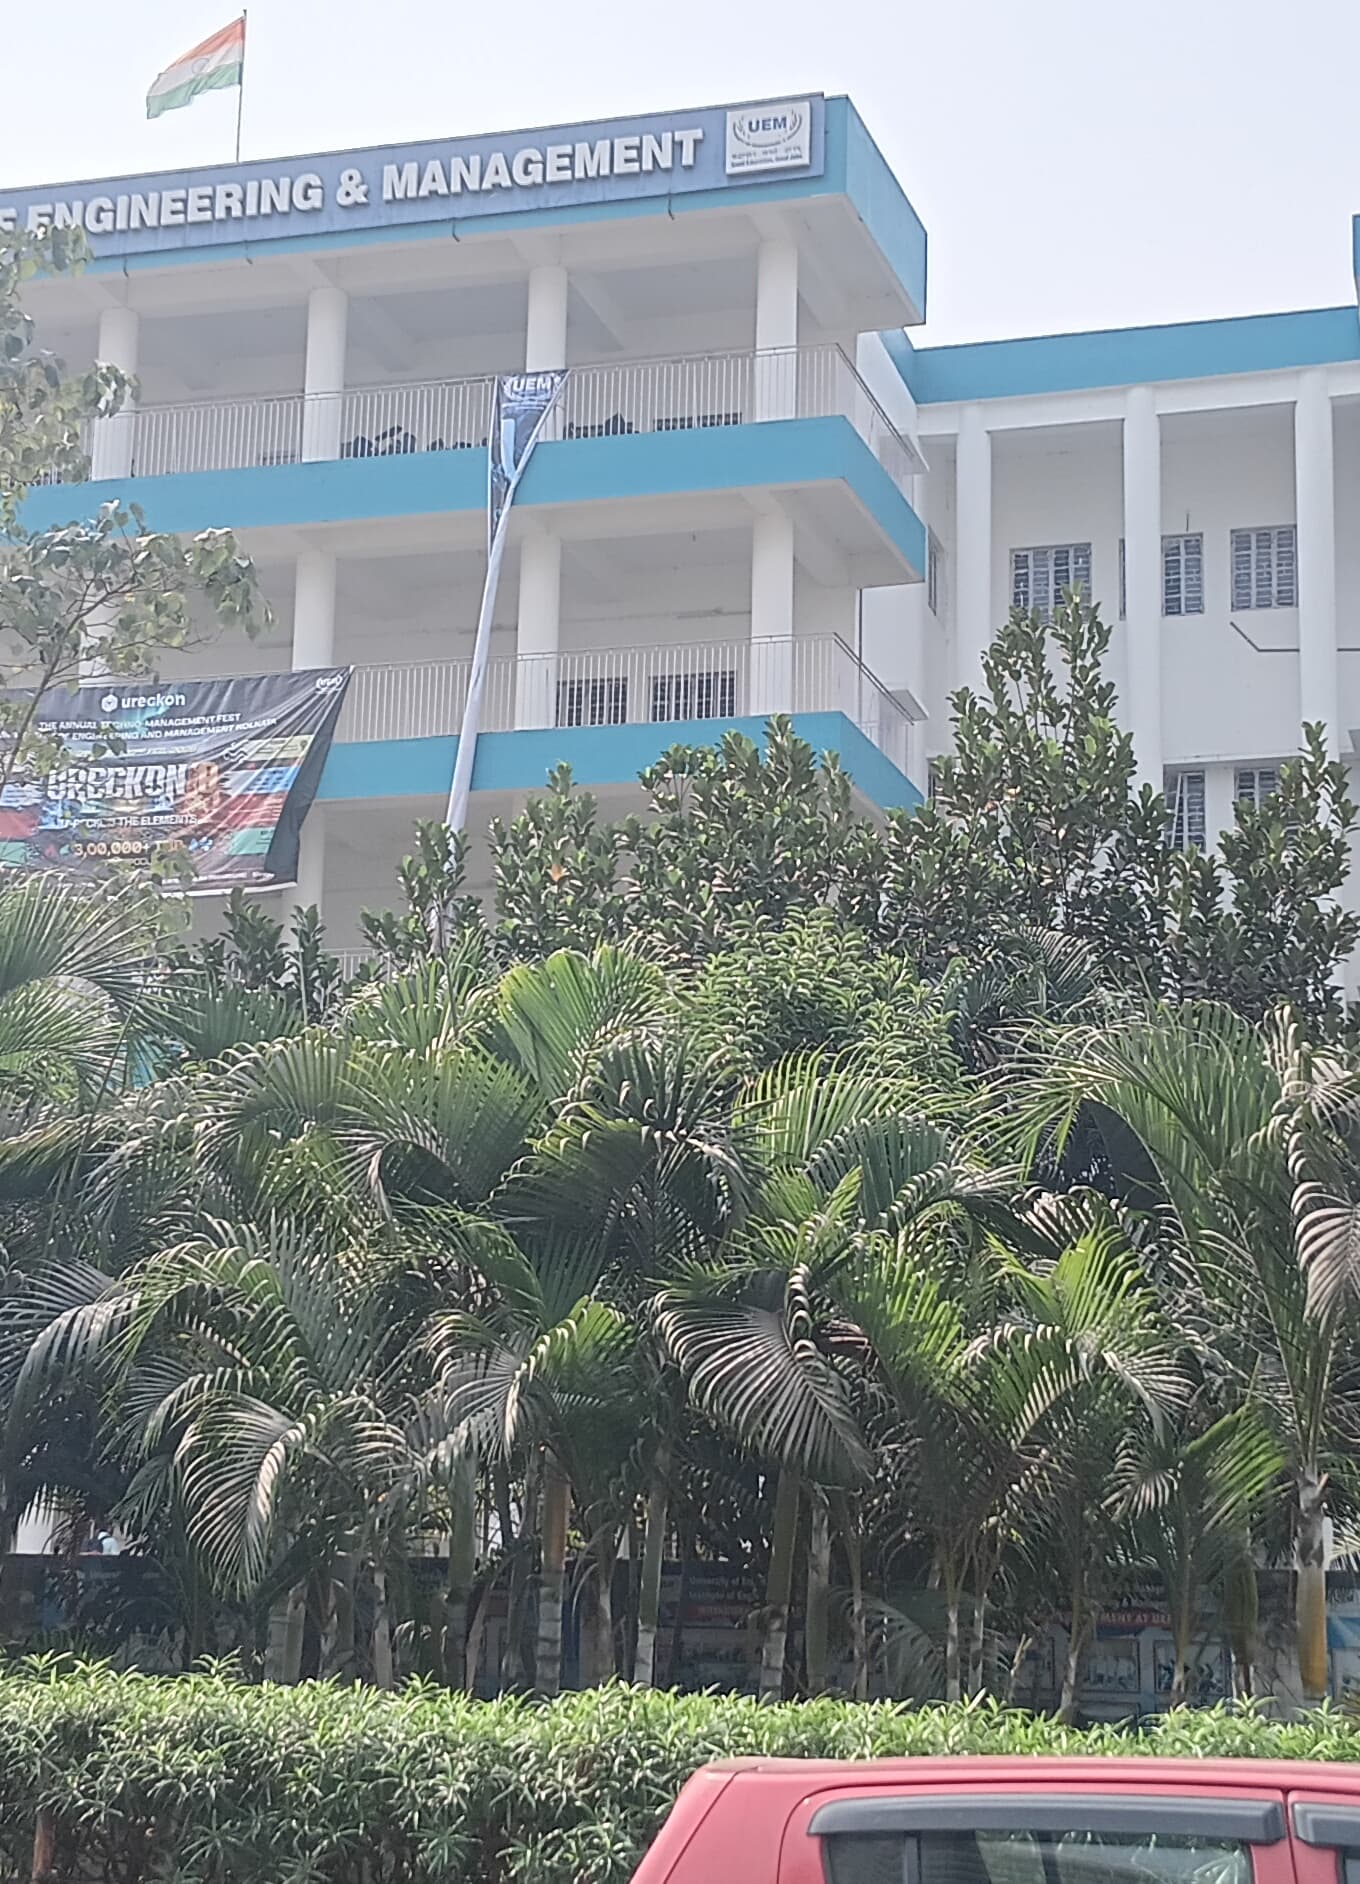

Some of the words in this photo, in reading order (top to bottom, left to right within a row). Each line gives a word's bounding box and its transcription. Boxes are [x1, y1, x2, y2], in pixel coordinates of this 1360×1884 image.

[748, 116, 787, 133] UEM
[26, 173, 326, 235] ENGINEERING
[336, 167, 370, 207] &
[381, 128, 704, 201] MANAGEMENT
[512, 375, 552, 393] UEM
